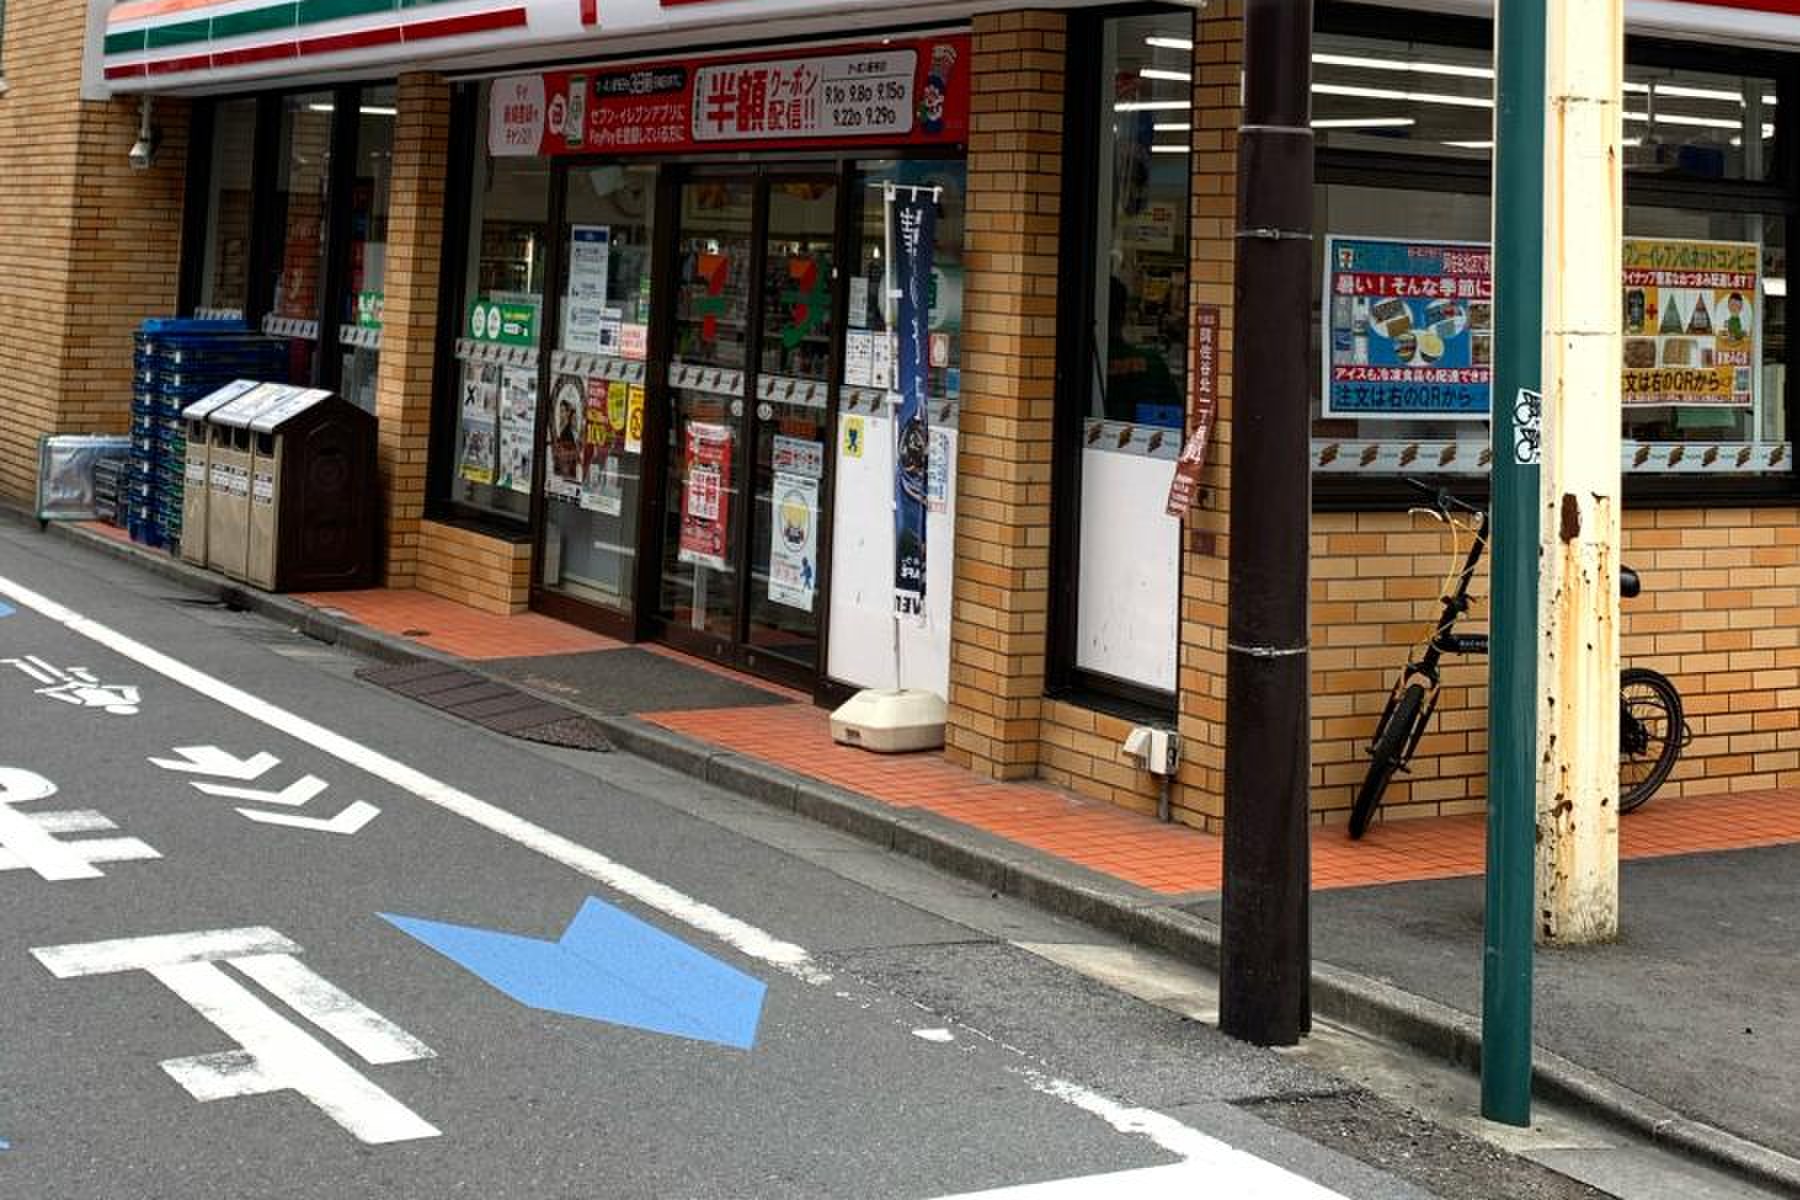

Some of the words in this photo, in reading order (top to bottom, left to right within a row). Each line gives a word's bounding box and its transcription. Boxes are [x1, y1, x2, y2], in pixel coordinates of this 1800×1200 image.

[770, 63, 819, 97] クーポン
[706, 69, 769, 133] 半額
[1622, 370, 1720, 393] 文は右のQRから
[1334, 385, 1472, 408] 注文は右のQRから
